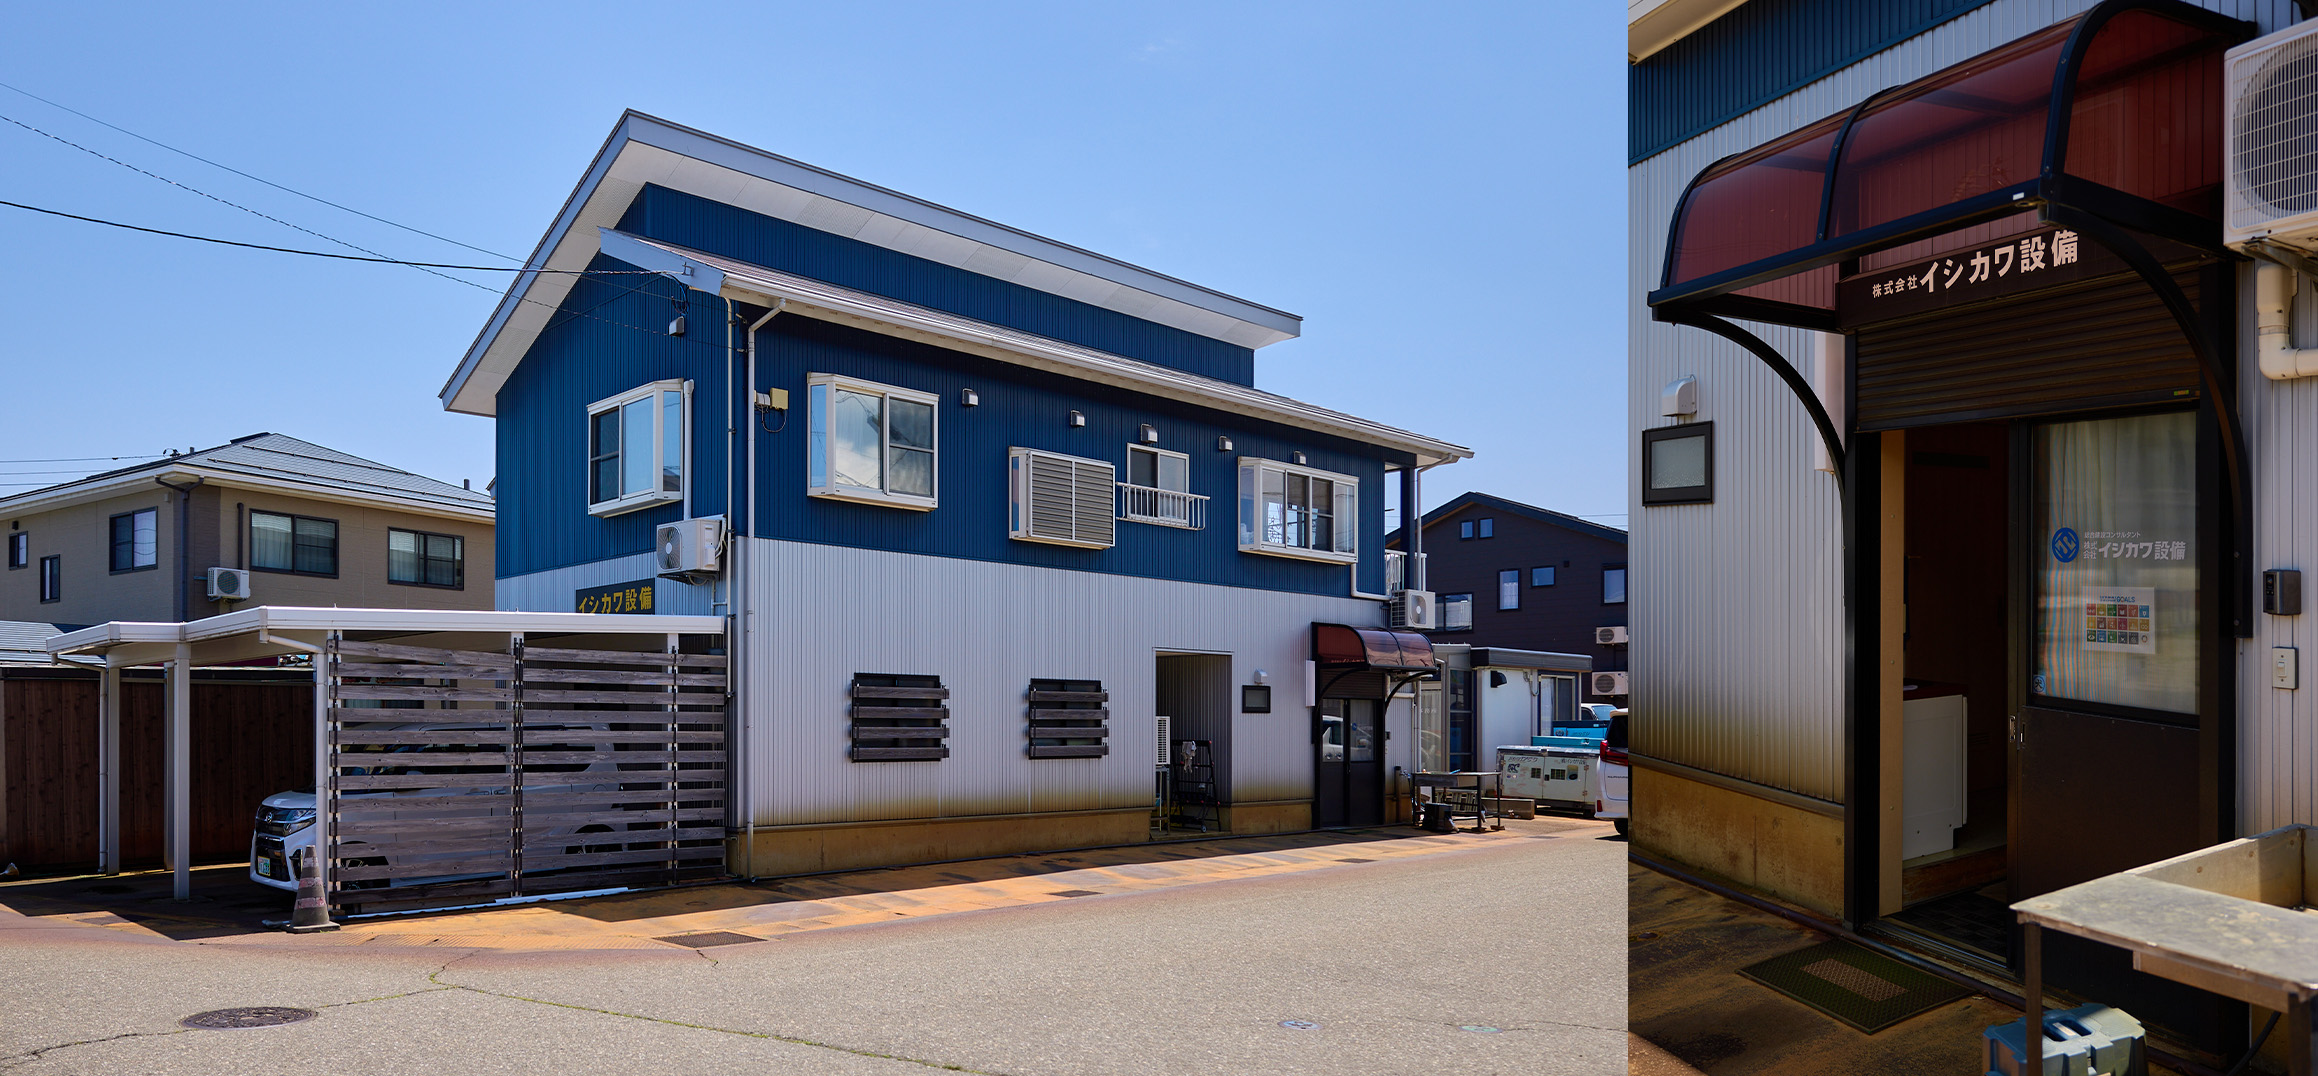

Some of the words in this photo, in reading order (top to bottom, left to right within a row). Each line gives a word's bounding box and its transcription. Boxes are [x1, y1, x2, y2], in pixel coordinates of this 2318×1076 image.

[1872, 275, 1918, 298] 株式会社
[1919, 229, 2079, 293] イシカワ設備
[2098, 541, 2187, 560] イシカワ設備
[578, 586, 652, 614] イシカワ設備
